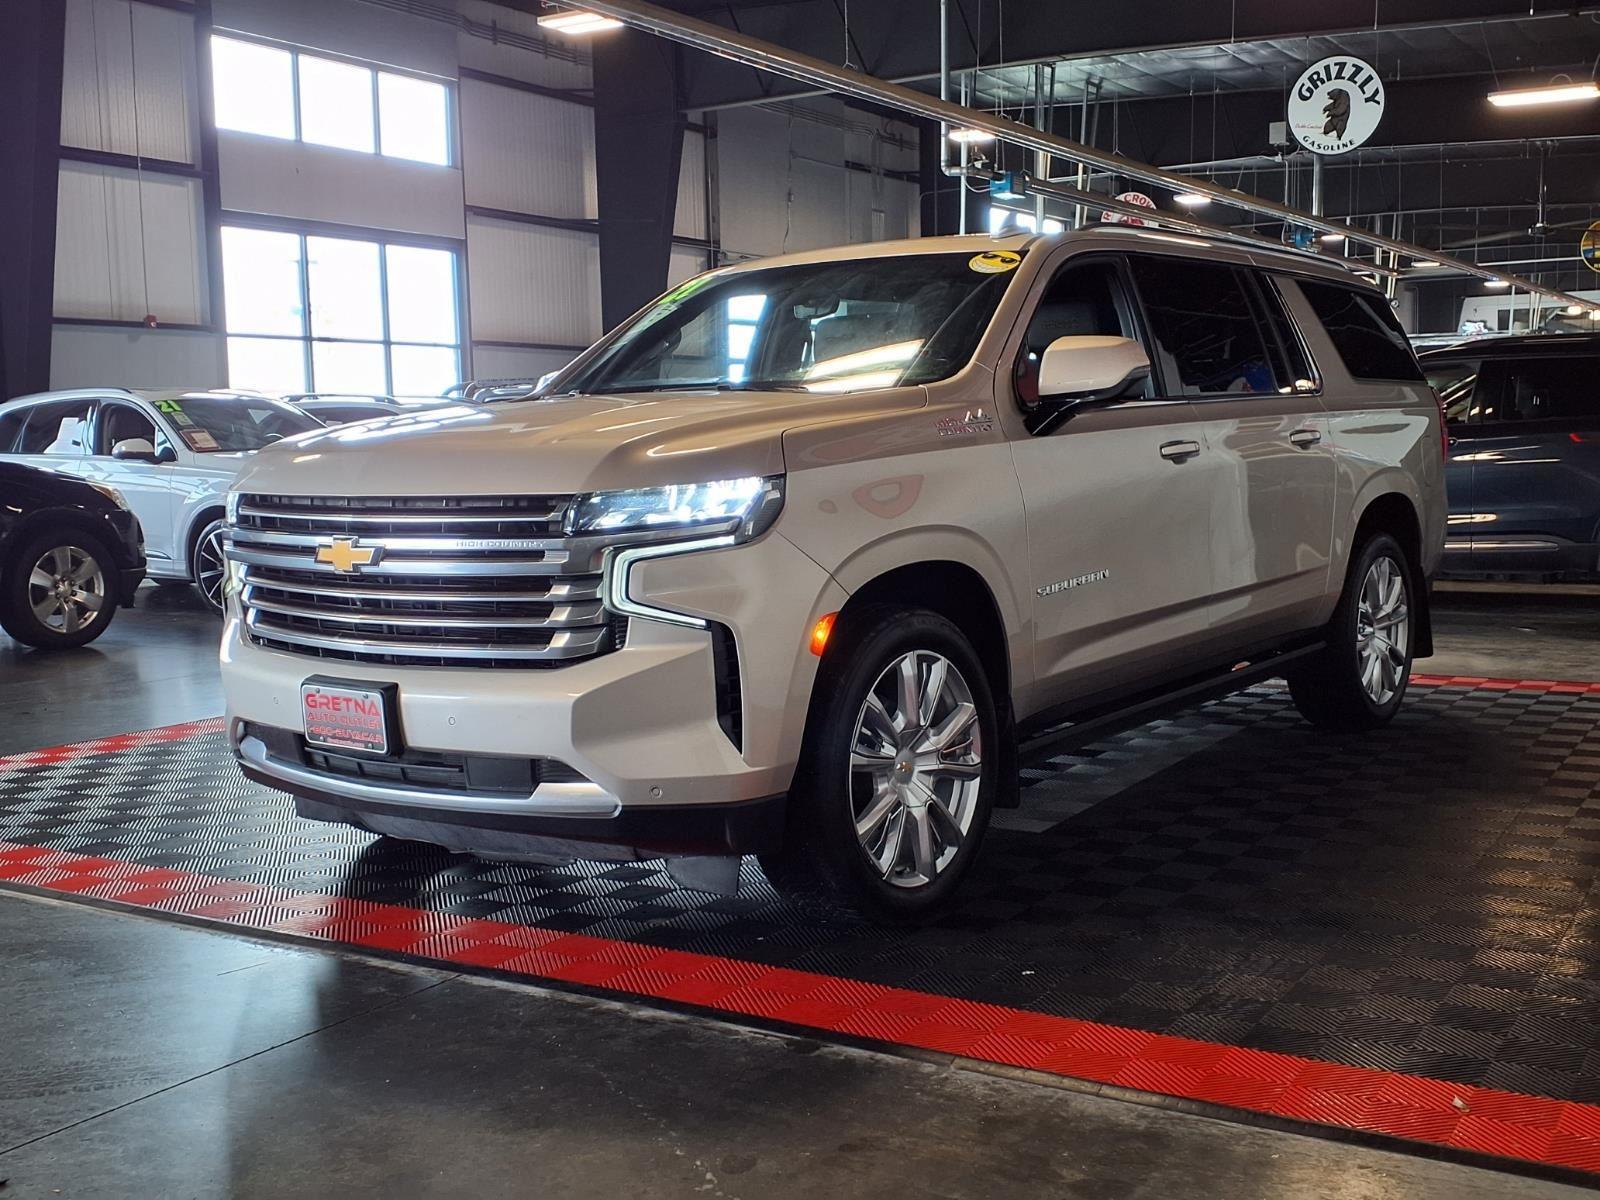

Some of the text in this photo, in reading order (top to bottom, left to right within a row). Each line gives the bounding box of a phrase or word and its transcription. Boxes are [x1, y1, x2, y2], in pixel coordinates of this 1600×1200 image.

[1298, 61, 1381, 105] GRIZZLY
[1303, 135, 1355, 151] GASOLINE
[155, 400, 182, 412] 21
[1036, 568, 1109, 598] SUBURBAN
[305, 693, 380, 716] GRETNA
[307, 711, 336, 723] AUTO
